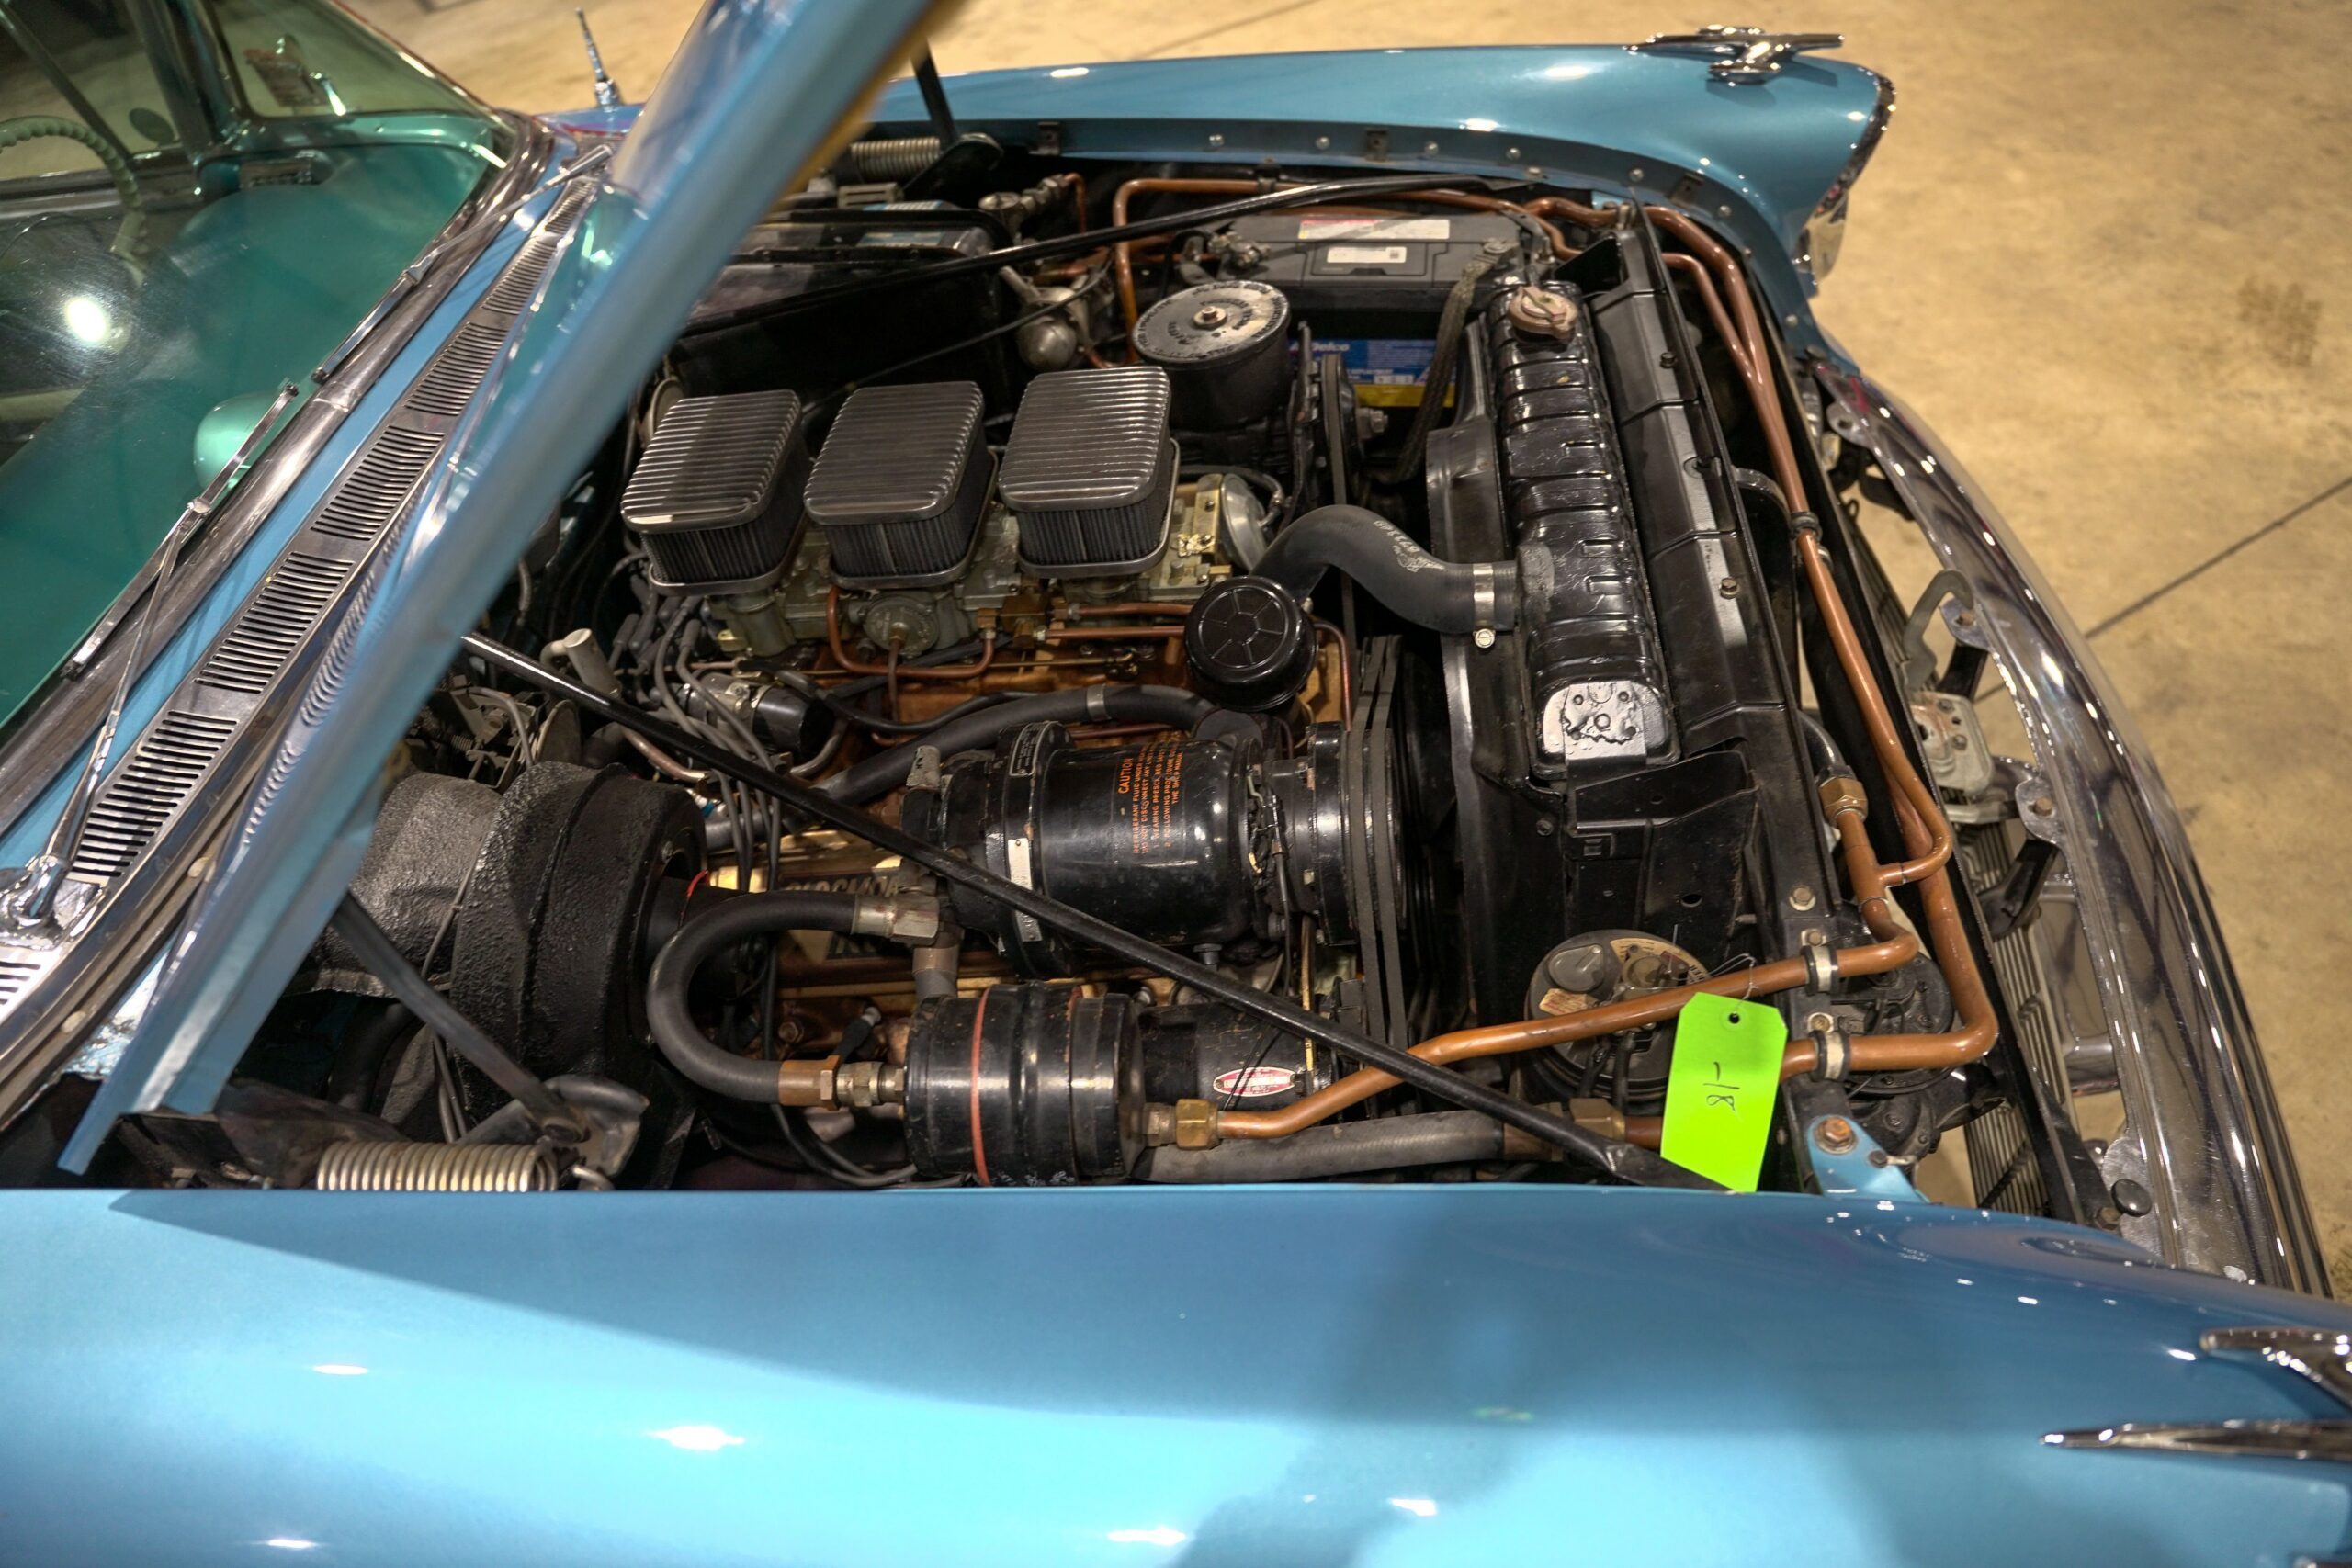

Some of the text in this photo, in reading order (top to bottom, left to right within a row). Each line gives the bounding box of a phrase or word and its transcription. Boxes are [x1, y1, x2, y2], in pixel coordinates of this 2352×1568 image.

[1117, 756, 1133, 794] CAUTION
[1132, 782, 1140, 801] FLUID
[1140, 778, 1148, 821] DISCONNECT
[1132, 803, 1140, 852] REFRIGERANT
